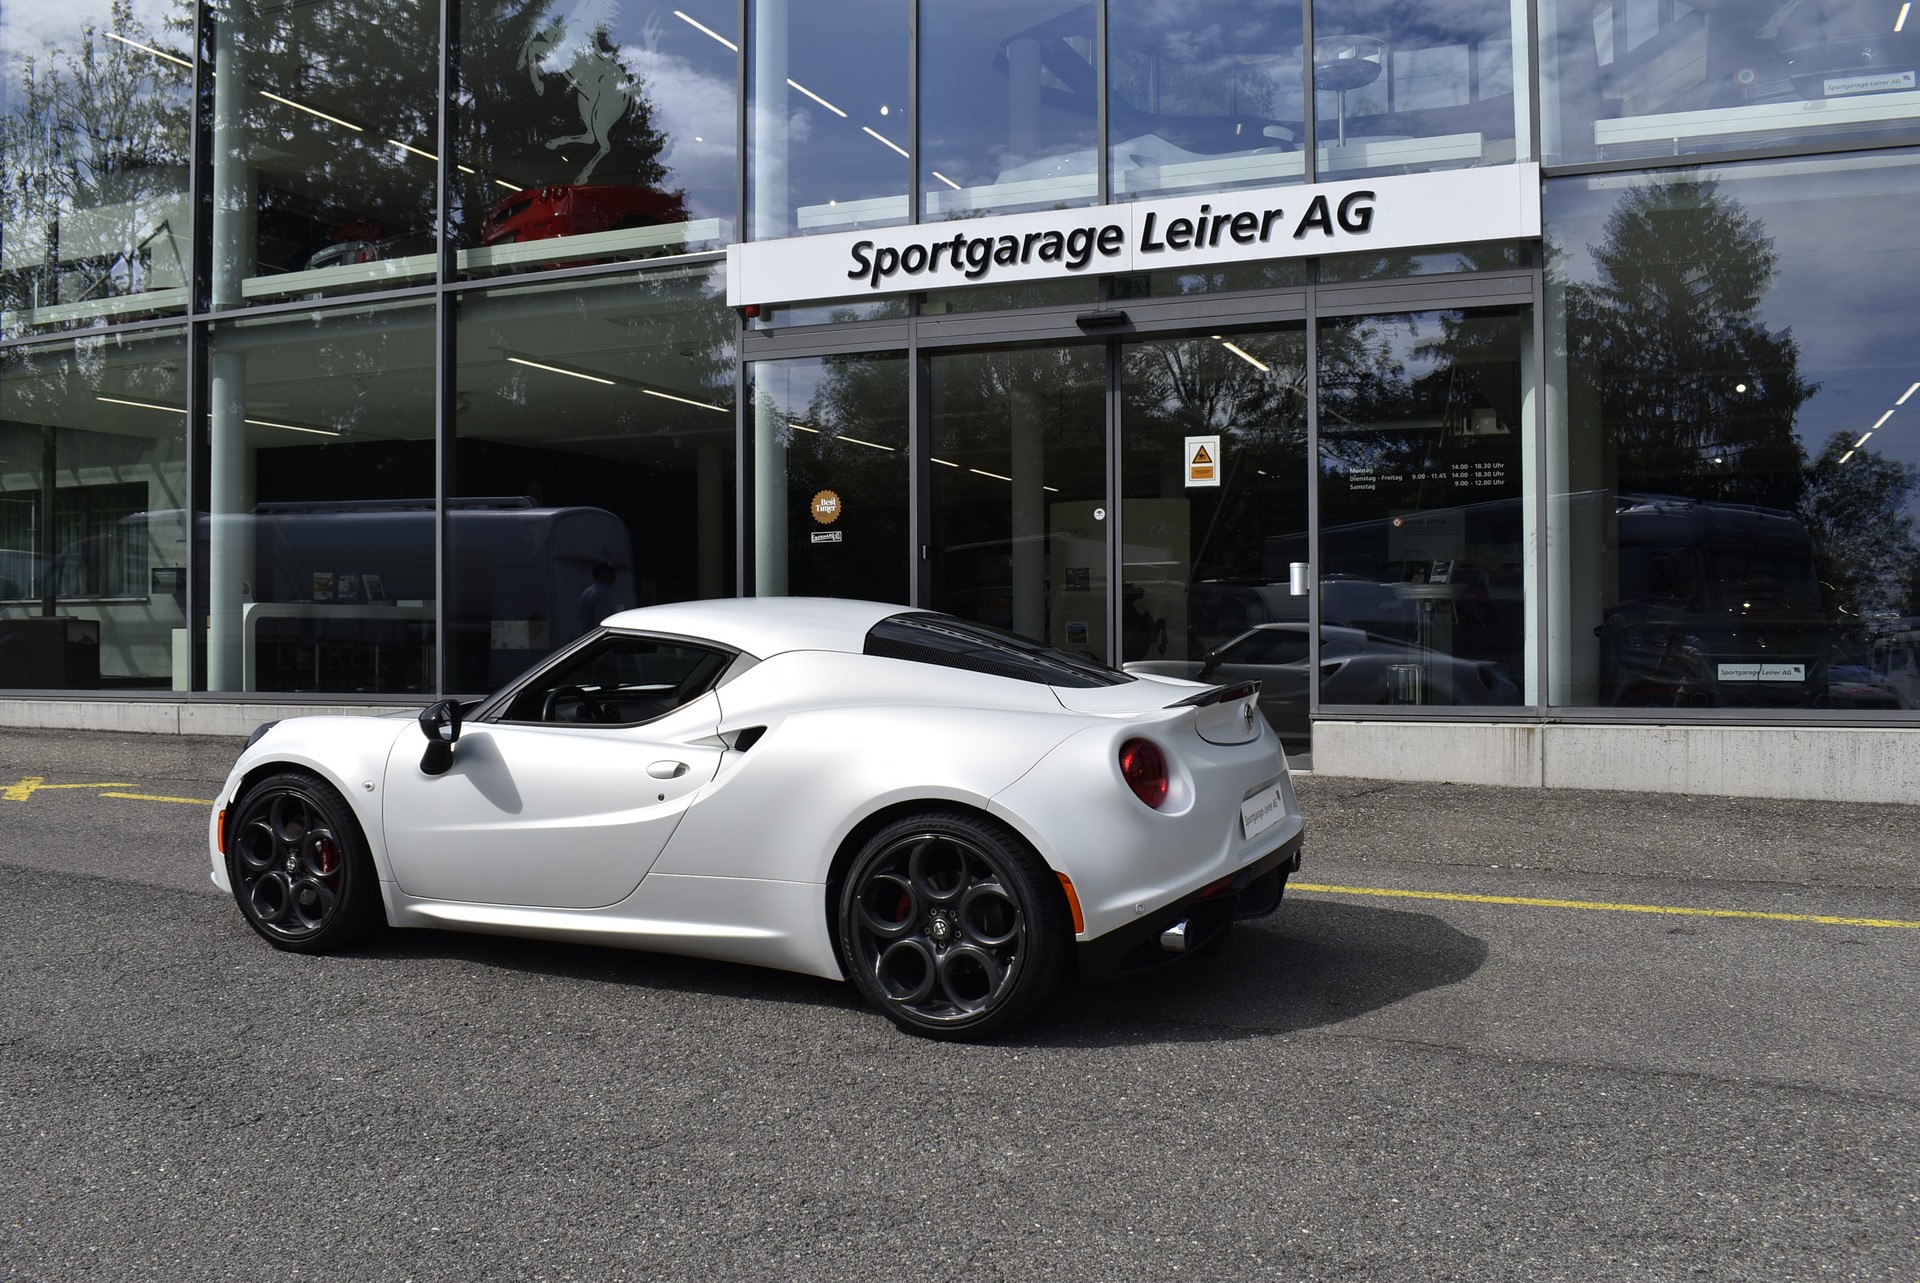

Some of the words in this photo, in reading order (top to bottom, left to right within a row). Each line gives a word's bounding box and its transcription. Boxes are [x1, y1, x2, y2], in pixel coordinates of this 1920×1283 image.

[1827, 82, 1868, 91] Sportgarage
[1870, 79, 1890, 87] Leirer
[847, 223, 1124, 288] Sportgarage
[1139, 203, 1285, 254] Leirer
[1293, 190, 1376, 240] AG
[1349, 467, 1373, 475] Montag
[1381, 474, 1403, 482] Freitag
[820, 497, 836, 505] Best
